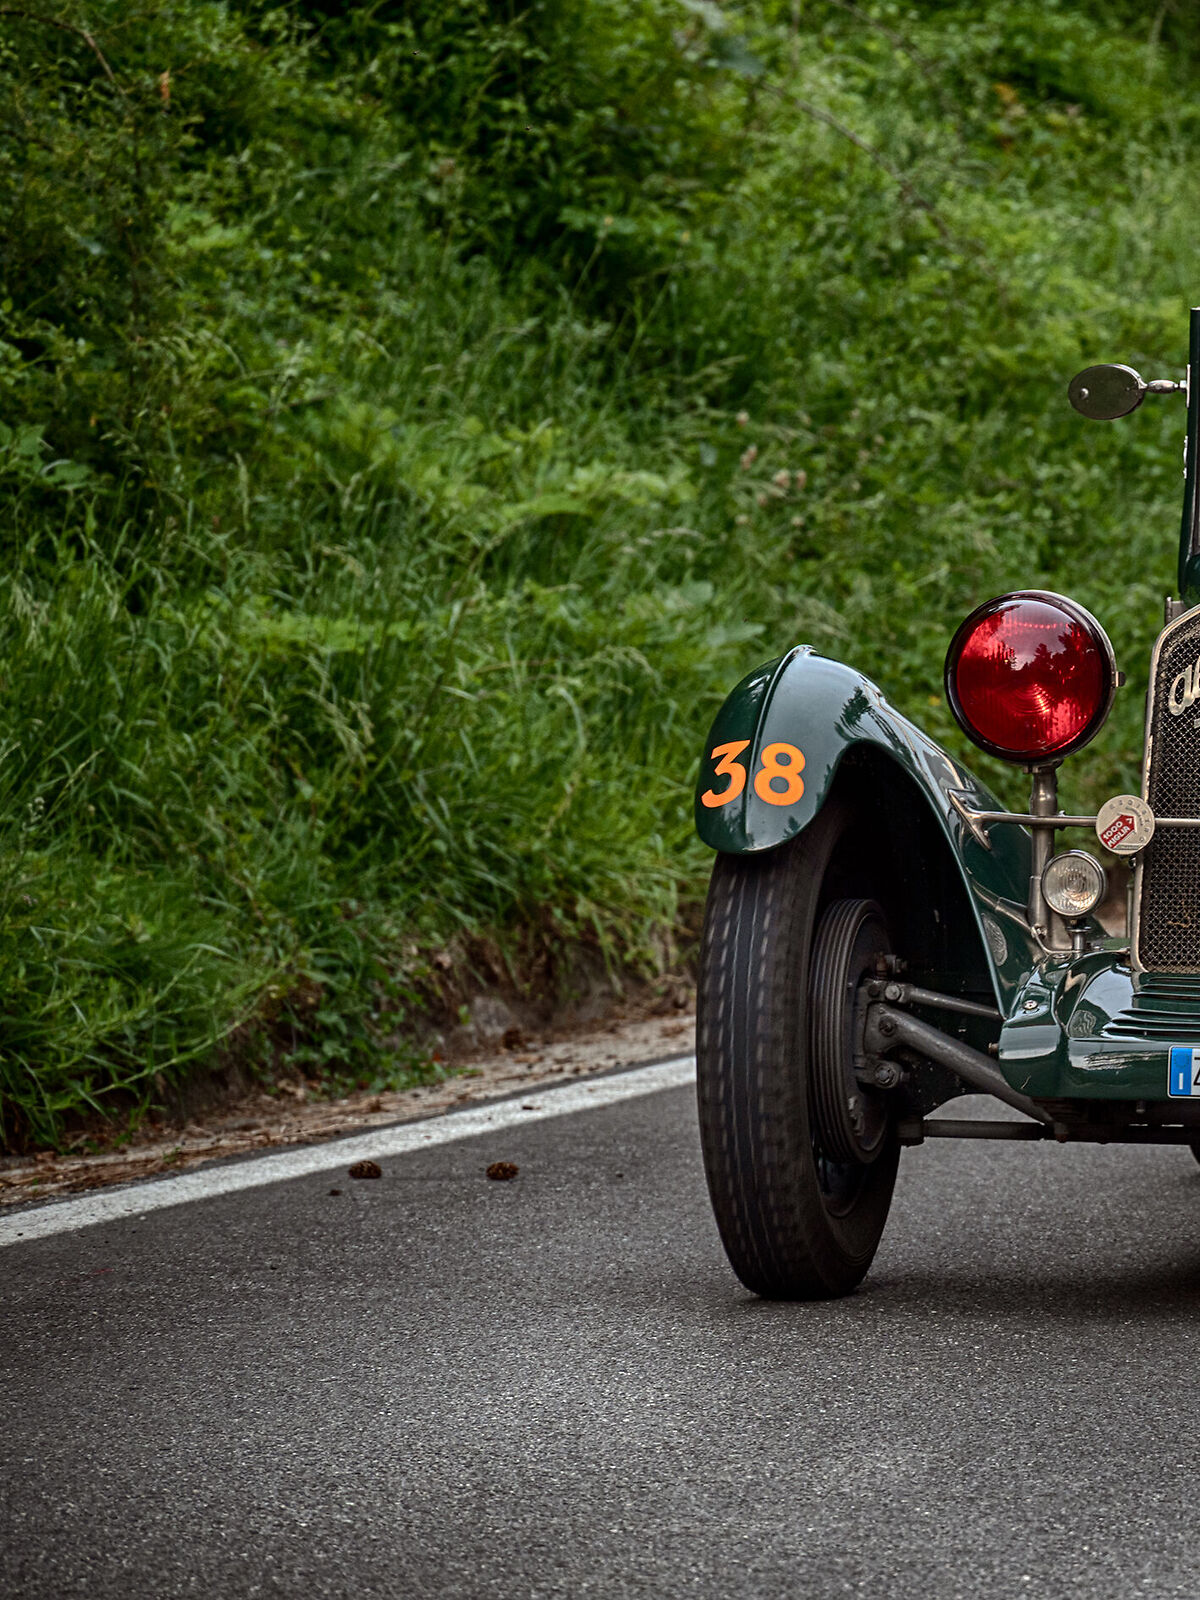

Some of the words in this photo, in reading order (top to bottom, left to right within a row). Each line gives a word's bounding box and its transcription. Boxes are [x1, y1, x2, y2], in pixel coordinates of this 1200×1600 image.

[701, 739, 806, 808] 38
[1102, 821, 1123, 840] 1000
[1107, 825, 1131, 848] MIGLIA
